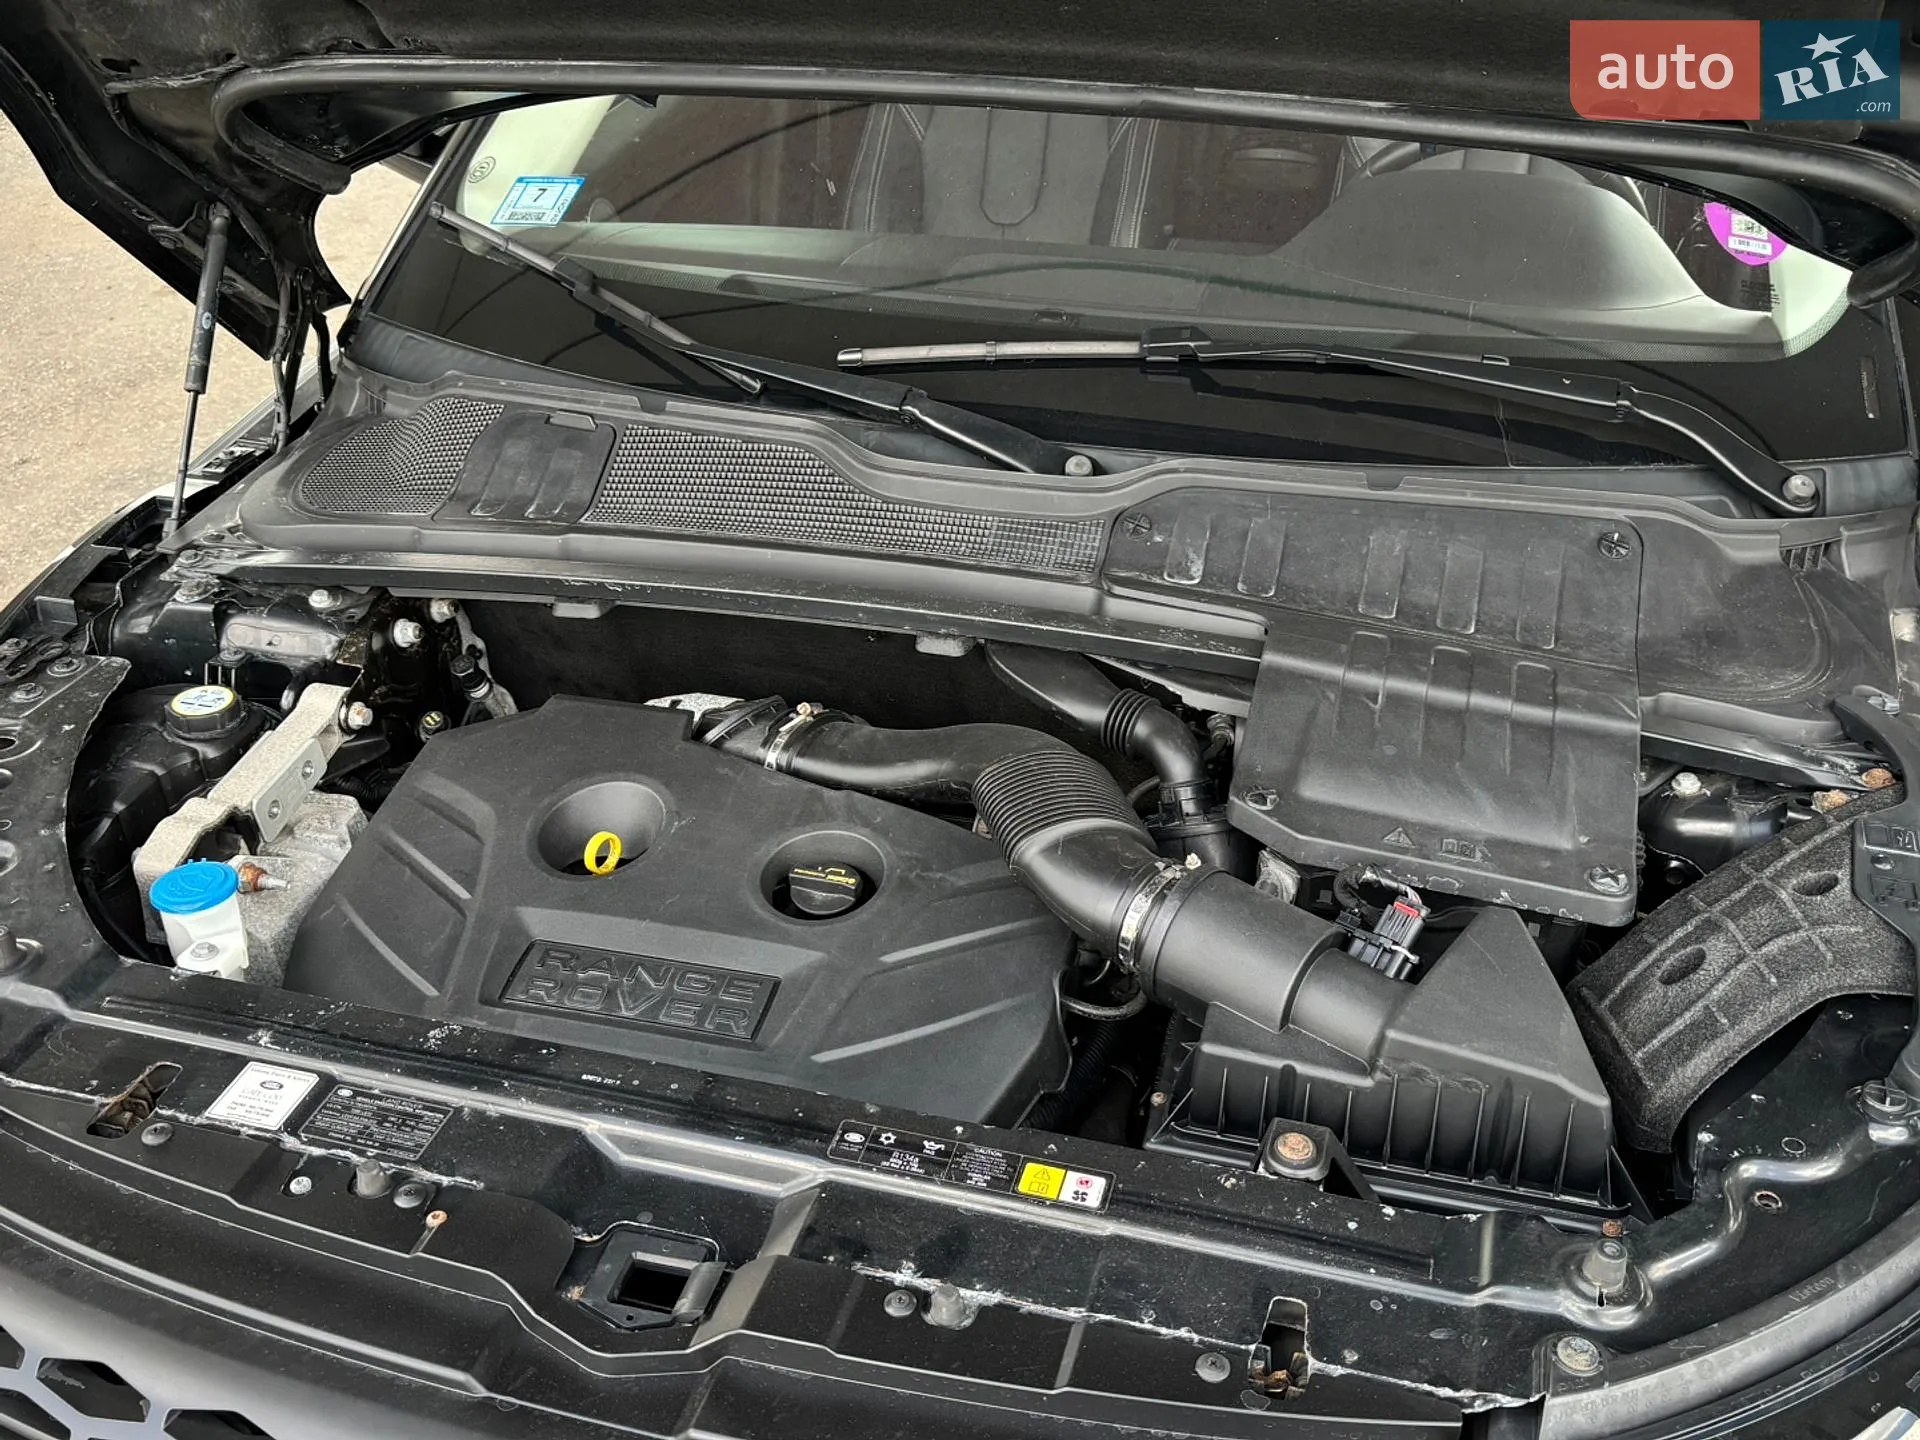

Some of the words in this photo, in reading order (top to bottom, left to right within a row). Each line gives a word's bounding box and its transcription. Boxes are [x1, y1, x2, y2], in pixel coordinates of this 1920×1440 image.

[532, 187, 547, 203] 7
[535, 948, 762, 1003] RANGE
[519, 977, 752, 1036] ROVER
